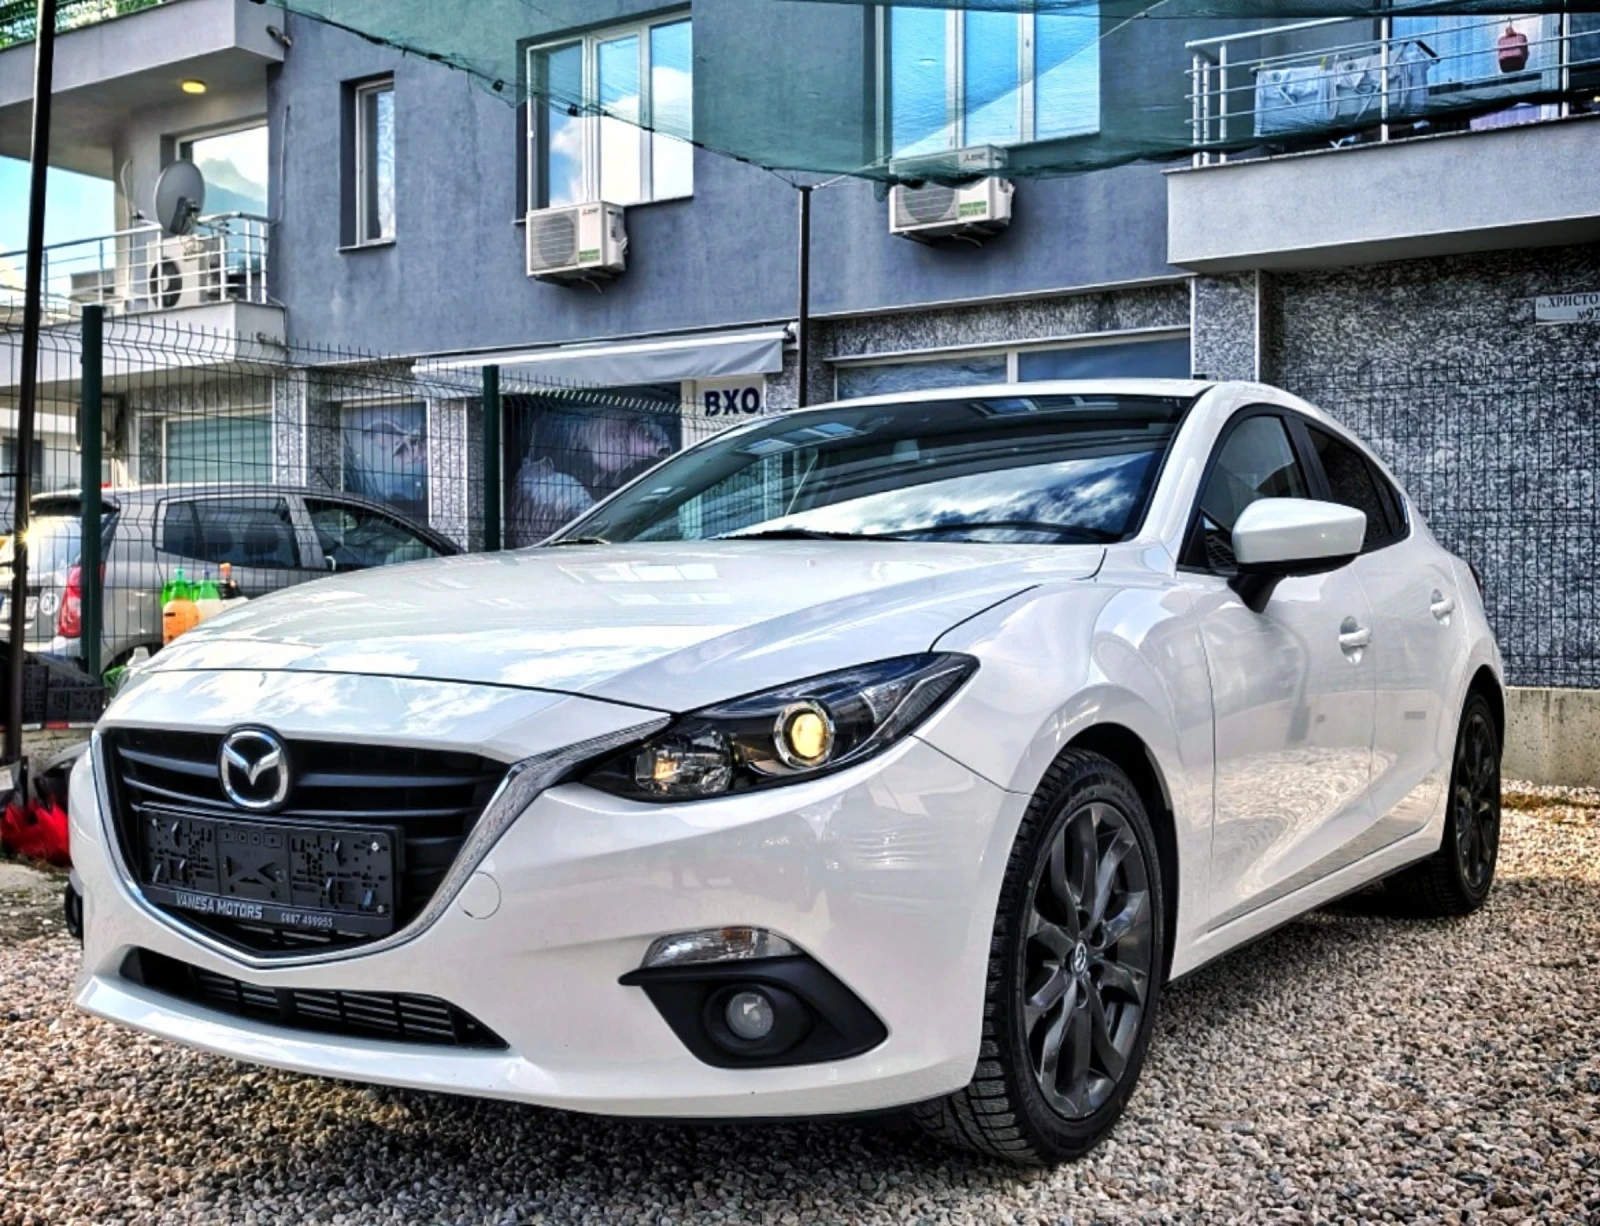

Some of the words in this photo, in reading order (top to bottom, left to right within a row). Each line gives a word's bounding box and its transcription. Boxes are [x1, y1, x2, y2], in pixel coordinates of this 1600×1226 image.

[704, 387, 763, 416] ВХО
[176, 892, 214, 912] VANESA
[217, 899, 263, 920] MOTORS
